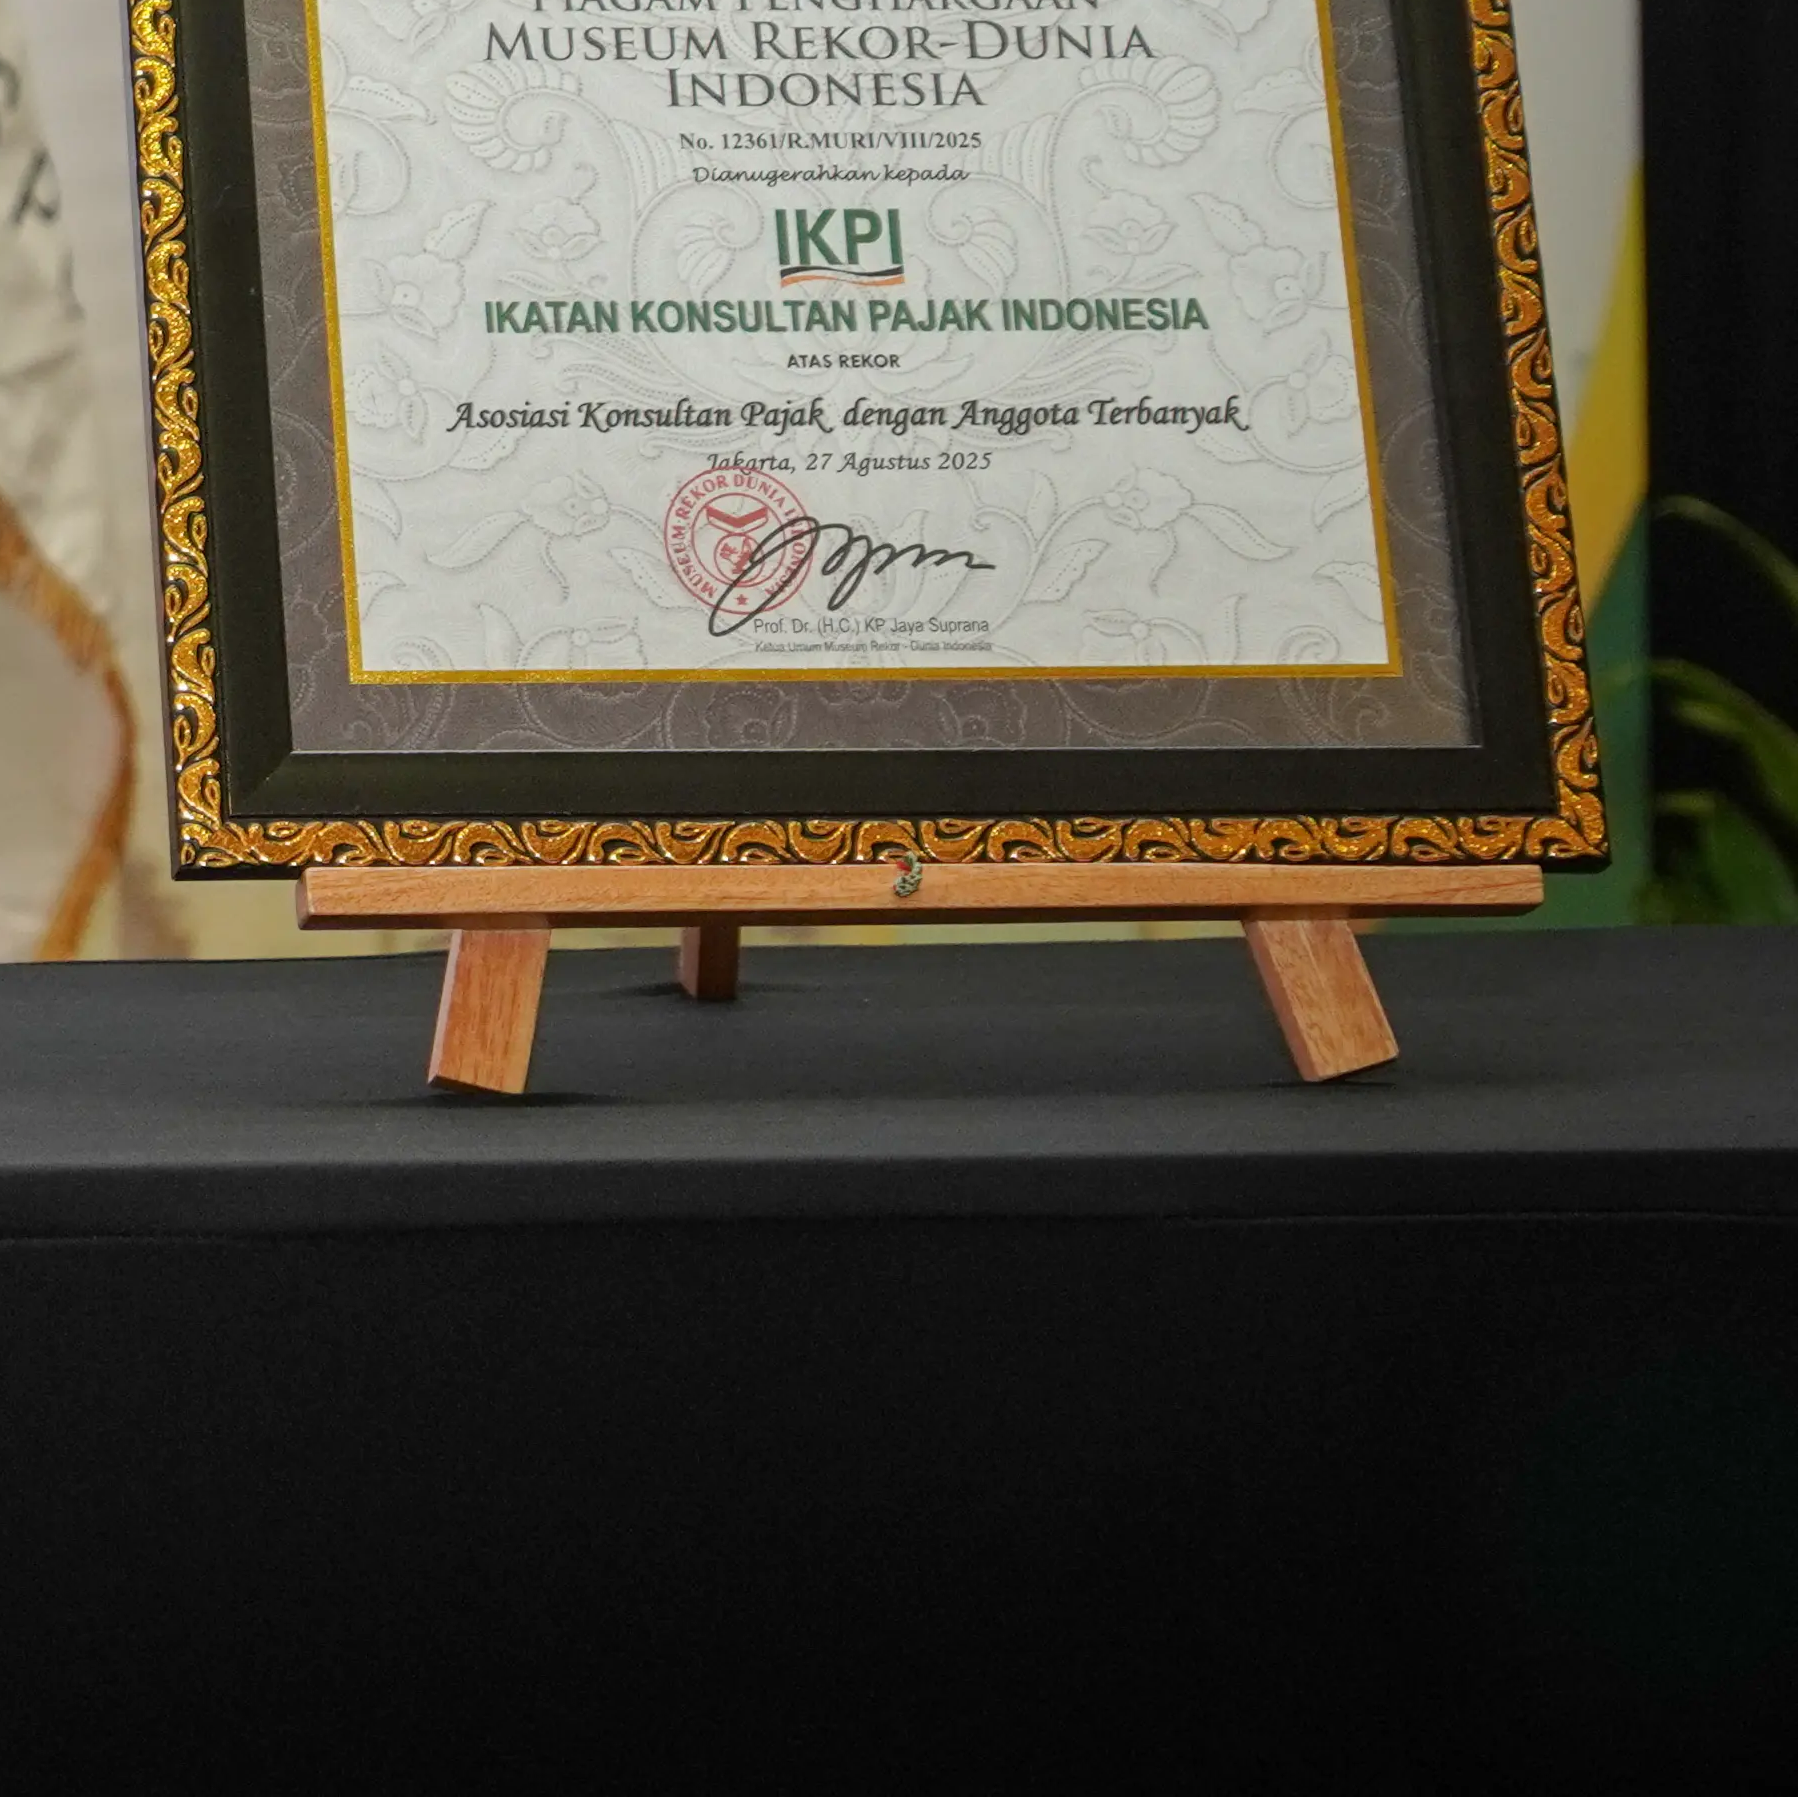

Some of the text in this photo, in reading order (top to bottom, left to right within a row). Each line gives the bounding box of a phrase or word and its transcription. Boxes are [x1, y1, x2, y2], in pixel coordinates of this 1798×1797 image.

[679, 131, 982, 151] No. 12361/R.MURI/VIII/2025
[692, 163, 971, 188] Dianugerahkan kepada
[774, 208, 905, 266] IKPI
[484, 297, 1210, 335] IKATAN KONSULTAN PAJAK INDONESIA
[787, 353, 901, 369] ATAS REKOR
[445, 394, 1251, 437] Asosiasi Konsultan Pajak dengan Anggota Terbanyak
[707, 451, 993, 477] Jakarta, 27 Agustus 2025
[675, 475, 729, 520] REKOR
[734, 474, 785, 508] DUNIA
[672, 525, 718, 598] MUSEUM
[755, 617, 989, 637] Prof. Dr. (H.C.) KP Jaya Suprana
